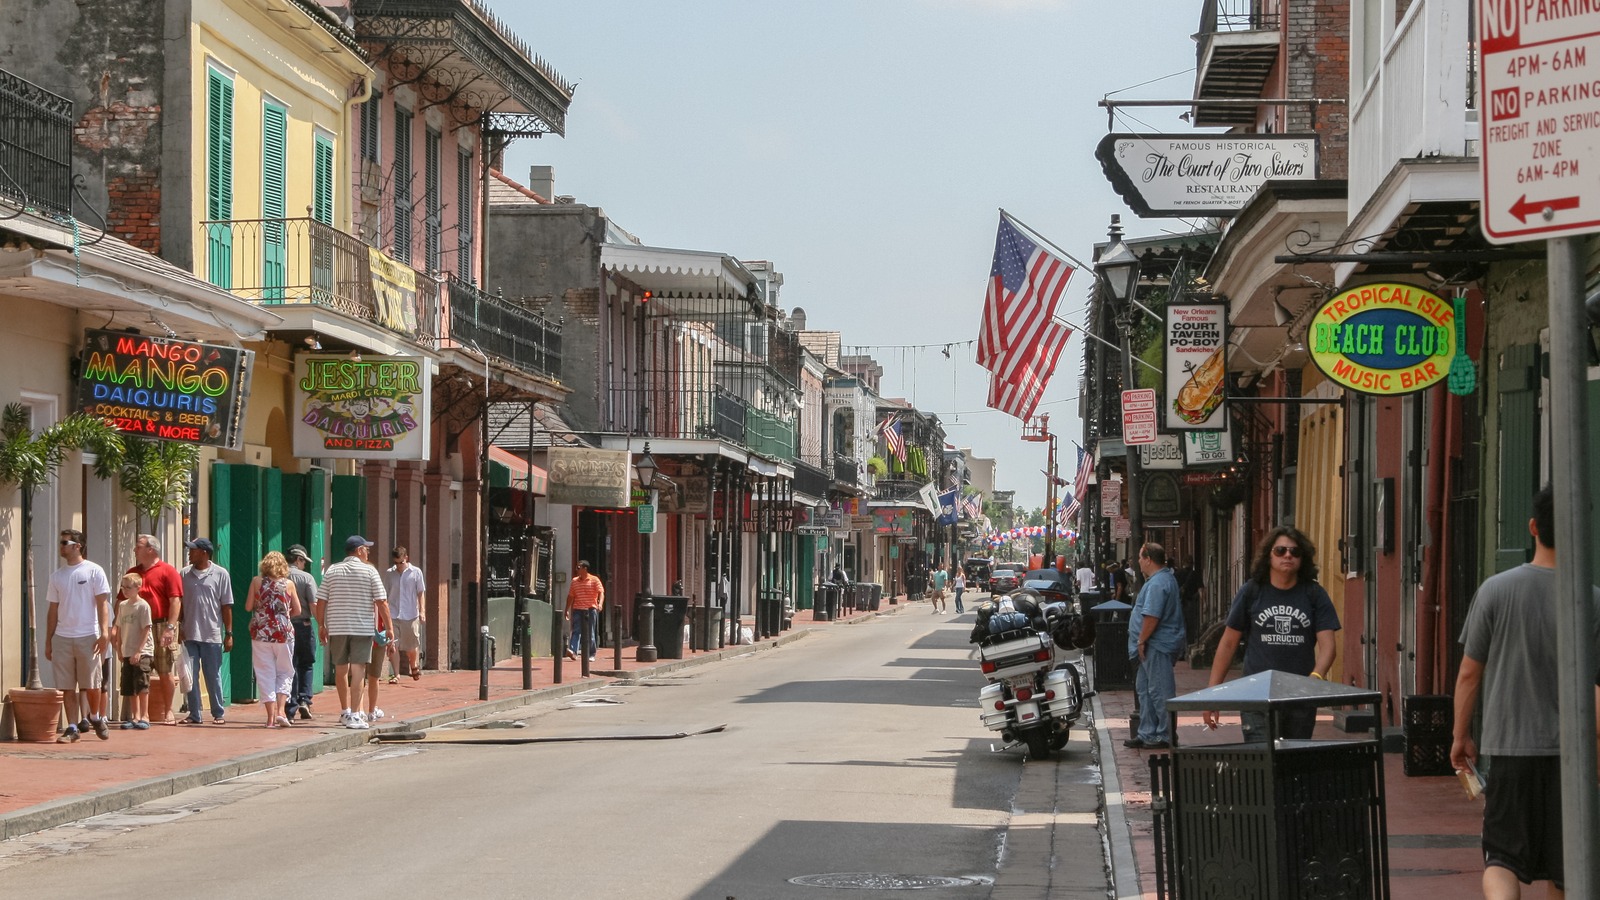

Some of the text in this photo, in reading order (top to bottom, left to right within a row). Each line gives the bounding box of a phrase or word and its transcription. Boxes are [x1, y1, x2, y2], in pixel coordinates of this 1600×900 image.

[1482, 0, 1516, 40] NO
[1494, 80, 1600, 117] NO PARKING
[1489, 122, 1530, 143] FREIGHT
[1537, 118, 1557, 136] AND
[1169, 142, 1277, 150] FAMOUS HISTORICAL
[1532, 139, 1562, 159] ZONE
[1142, 151, 1305, 183] The Court of Two Sisters
[1186, 184, 1260, 194] RESTAURANT
[1323, 287, 1455, 327] TROPICAL ISLE
[1171, 330, 1220, 338] TAVERN
[1173, 322, 1217, 330] COURT
[116, 337, 201, 363] MANGO
[1170, 338, 1220, 346] PO-BOY
[1315, 323, 1449, 356] BEACH CLUB
[84, 351, 230, 397] MANGO
[300, 359, 422, 394] JESTER
[1332, 359, 1440, 390] MUSIC BAR
[93, 383, 217, 414] DAIQUIRIS
[331, 388, 393, 401] MARDI GRAS
[1124, 393, 1131, 401] NO
[95, 403, 209, 425] COCKTAILS & BEER
[303, 412, 415, 438] DAIQUIRIS
[1124, 414, 1131, 422] NO
[104, 417, 200, 440] PIZZA & MORE
[325, 439, 392, 449] AND PIZZA
[1211, 450, 1225, 458] GO!
[584, 489, 624, 499] LOBSTER
[1255, 605, 1310, 627] LONGBOARD
[1261, 634, 1304, 643] INSTRUCTOR
